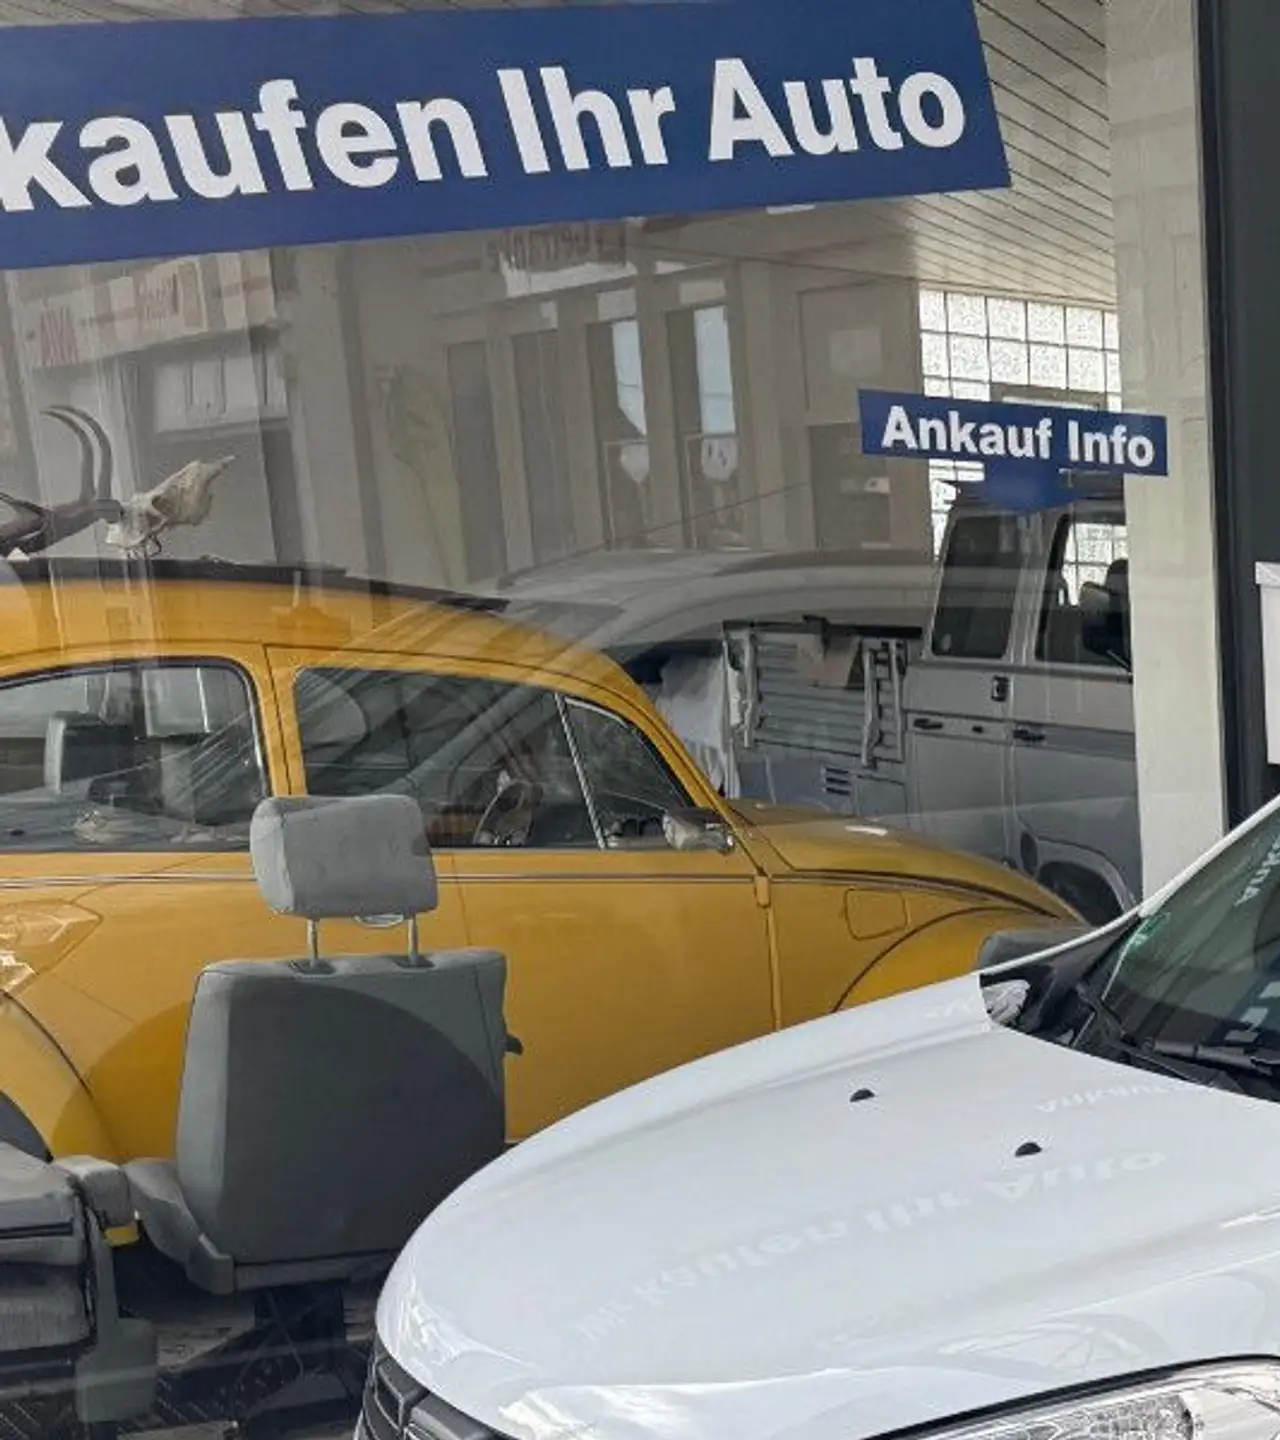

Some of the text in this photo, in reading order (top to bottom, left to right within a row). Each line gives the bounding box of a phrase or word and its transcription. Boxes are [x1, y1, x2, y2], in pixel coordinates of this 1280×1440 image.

[0, 57, 965, 212] kaufen Ihr Auto
[881, 404, 1154, 467] Ankauf Info
